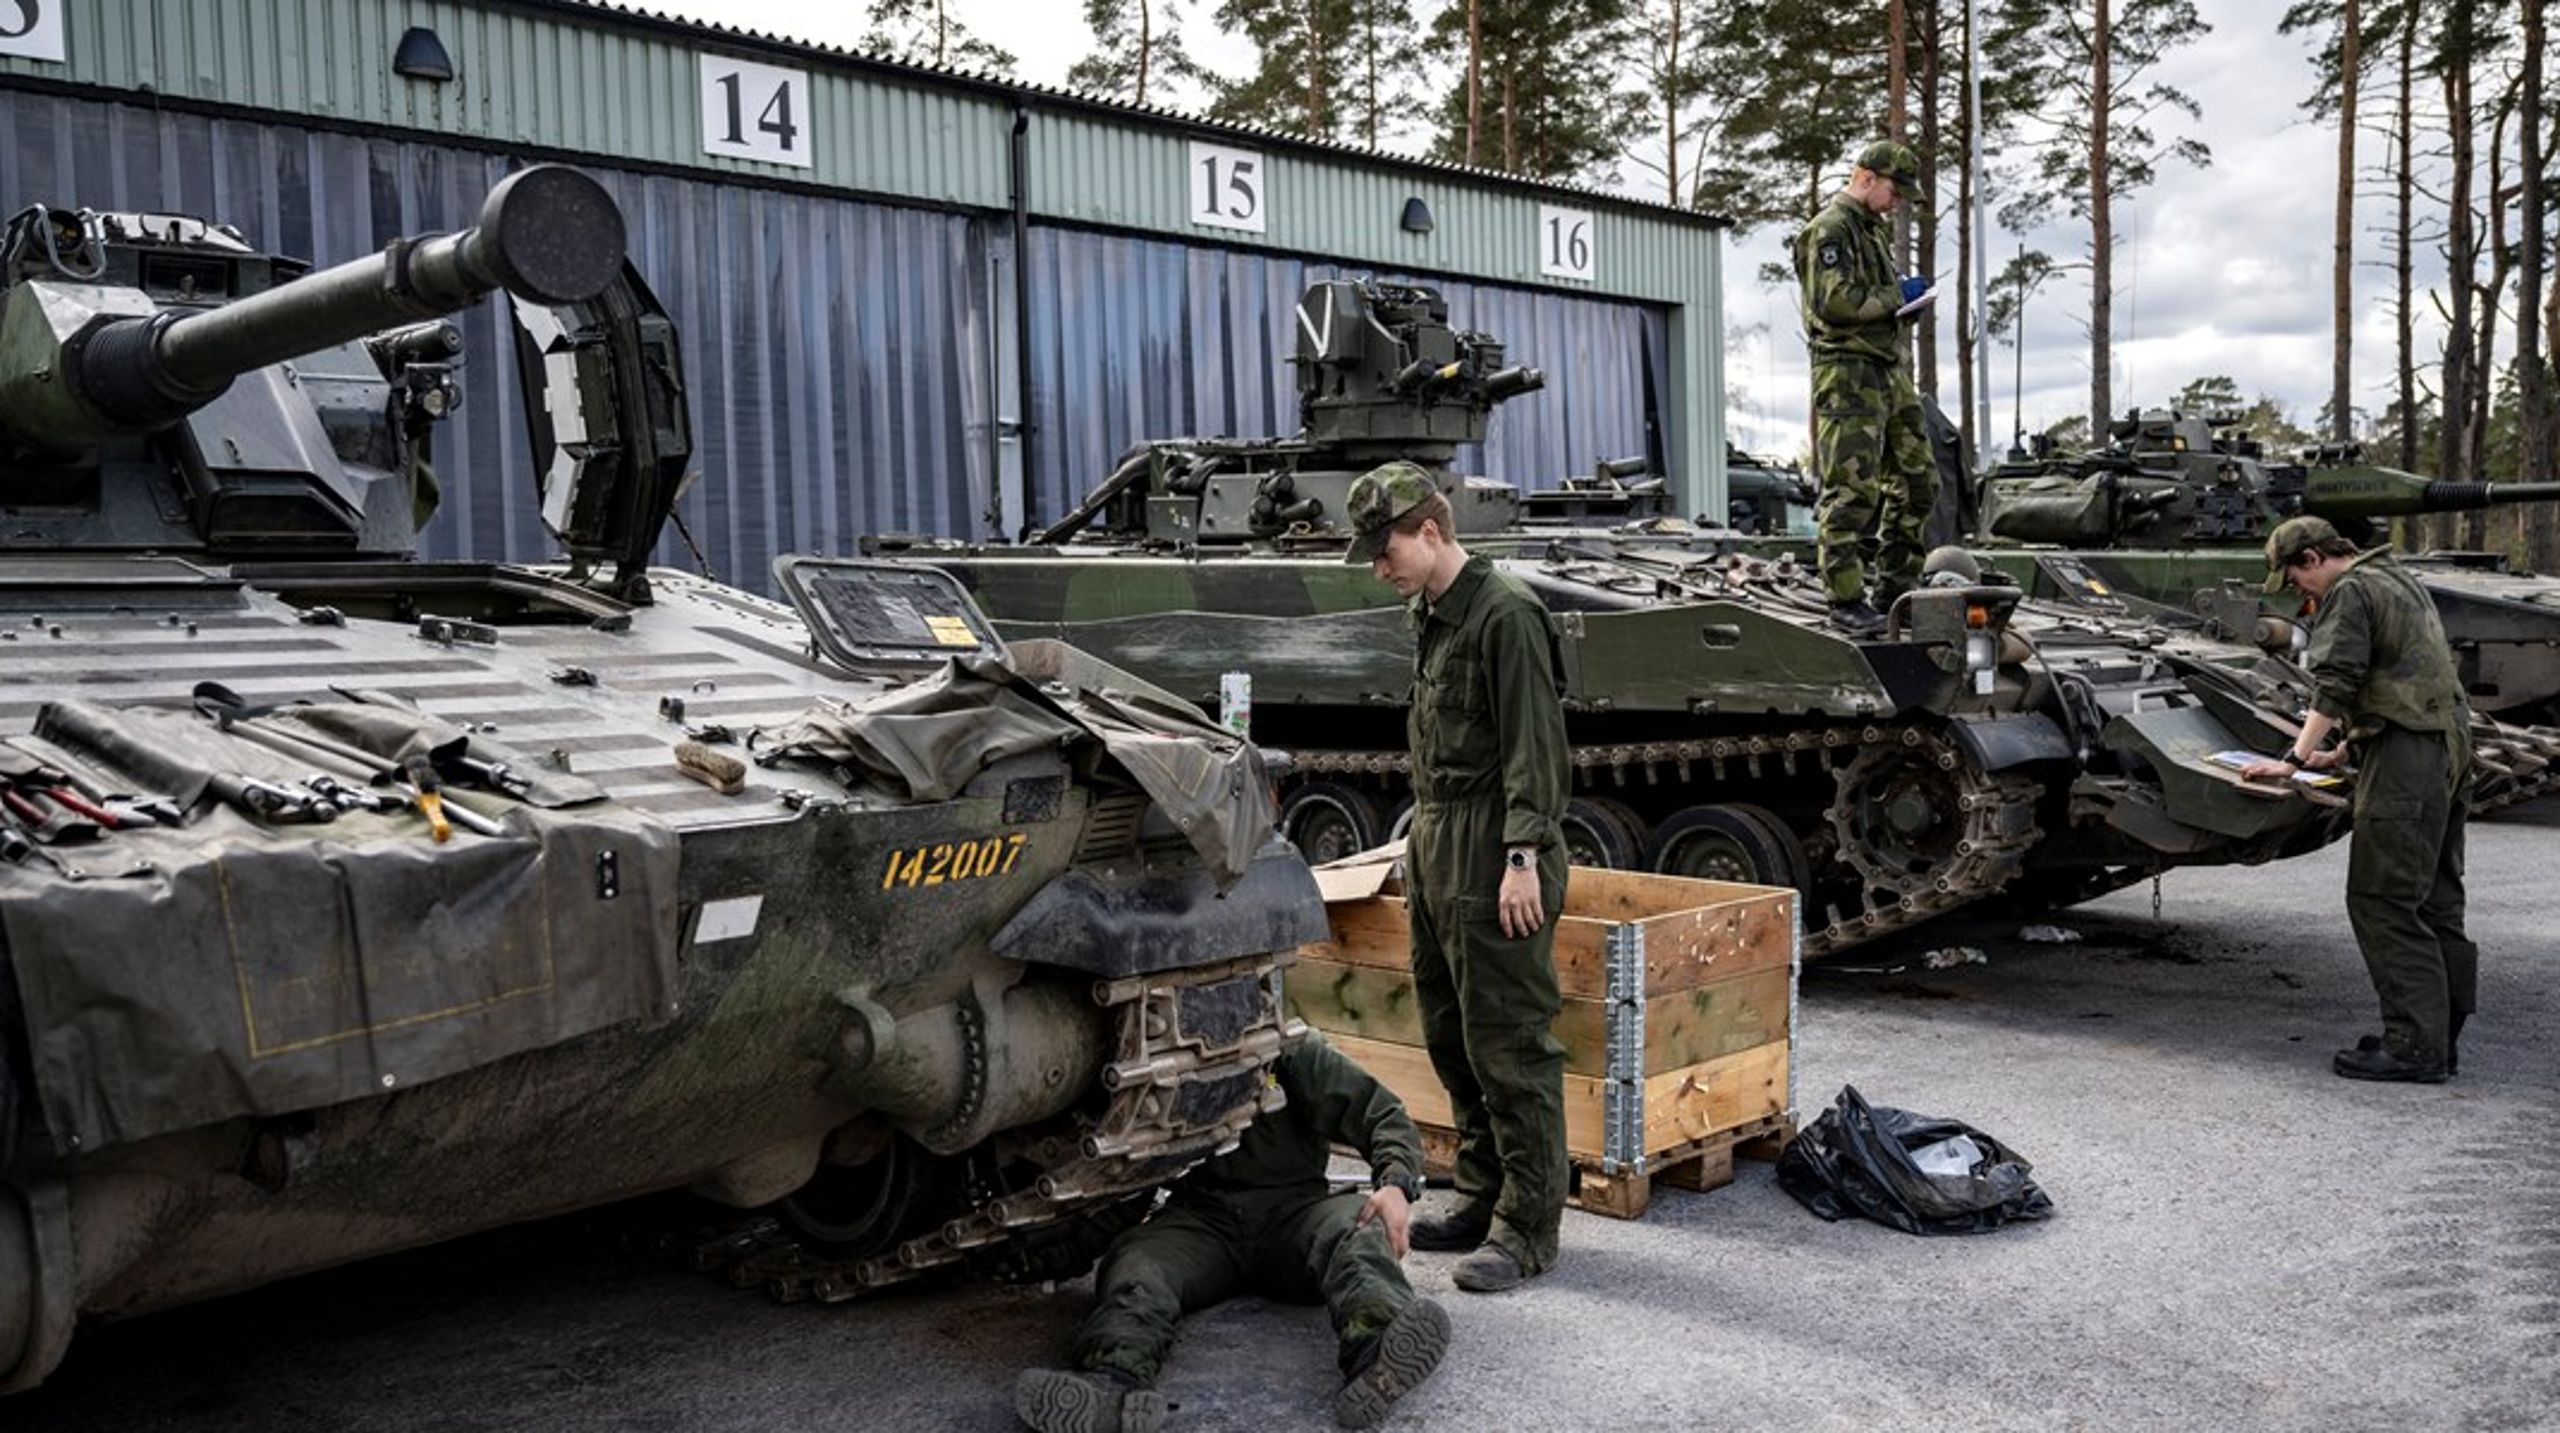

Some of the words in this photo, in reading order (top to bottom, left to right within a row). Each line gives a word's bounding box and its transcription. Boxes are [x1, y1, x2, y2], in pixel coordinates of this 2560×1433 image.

[716, 72, 797, 151] 14
[1201, 155, 1255, 219] 15
[1549, 216, 1587, 271] 16
[876, 831, 1028, 891] 142007
